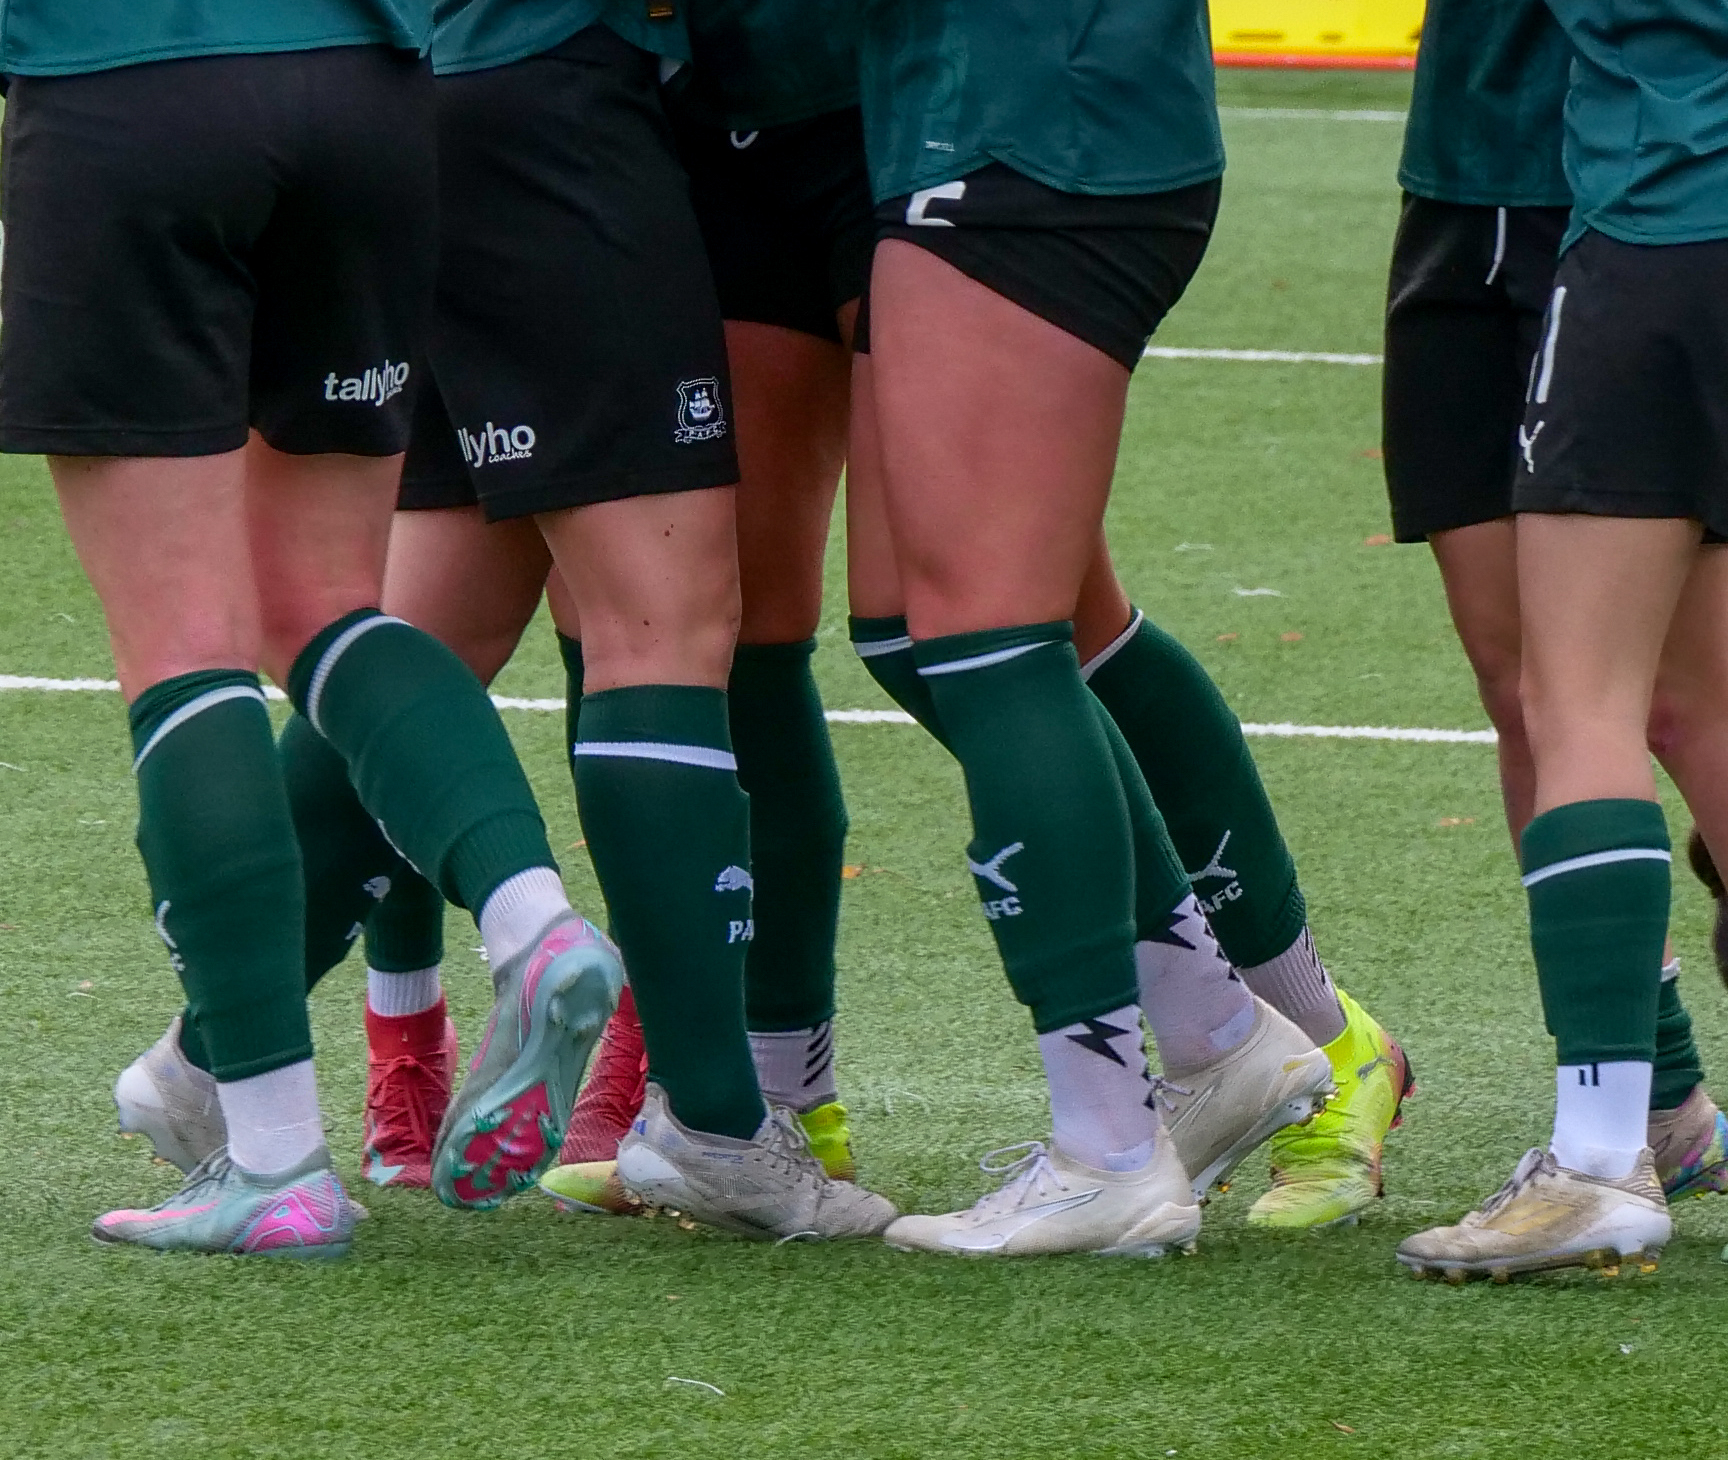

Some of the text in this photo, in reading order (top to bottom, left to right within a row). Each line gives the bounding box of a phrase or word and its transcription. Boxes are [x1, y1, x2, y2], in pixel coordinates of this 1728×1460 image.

[324, 359, 410, 407] tallyho
[457, 421, 536, 468] llyho
[488, 449, 533, 464] coaches
[982, 895, 1024, 921] AFC
[1197, 880, 1243, 915] AFC
[727, 919, 755, 944] PA
